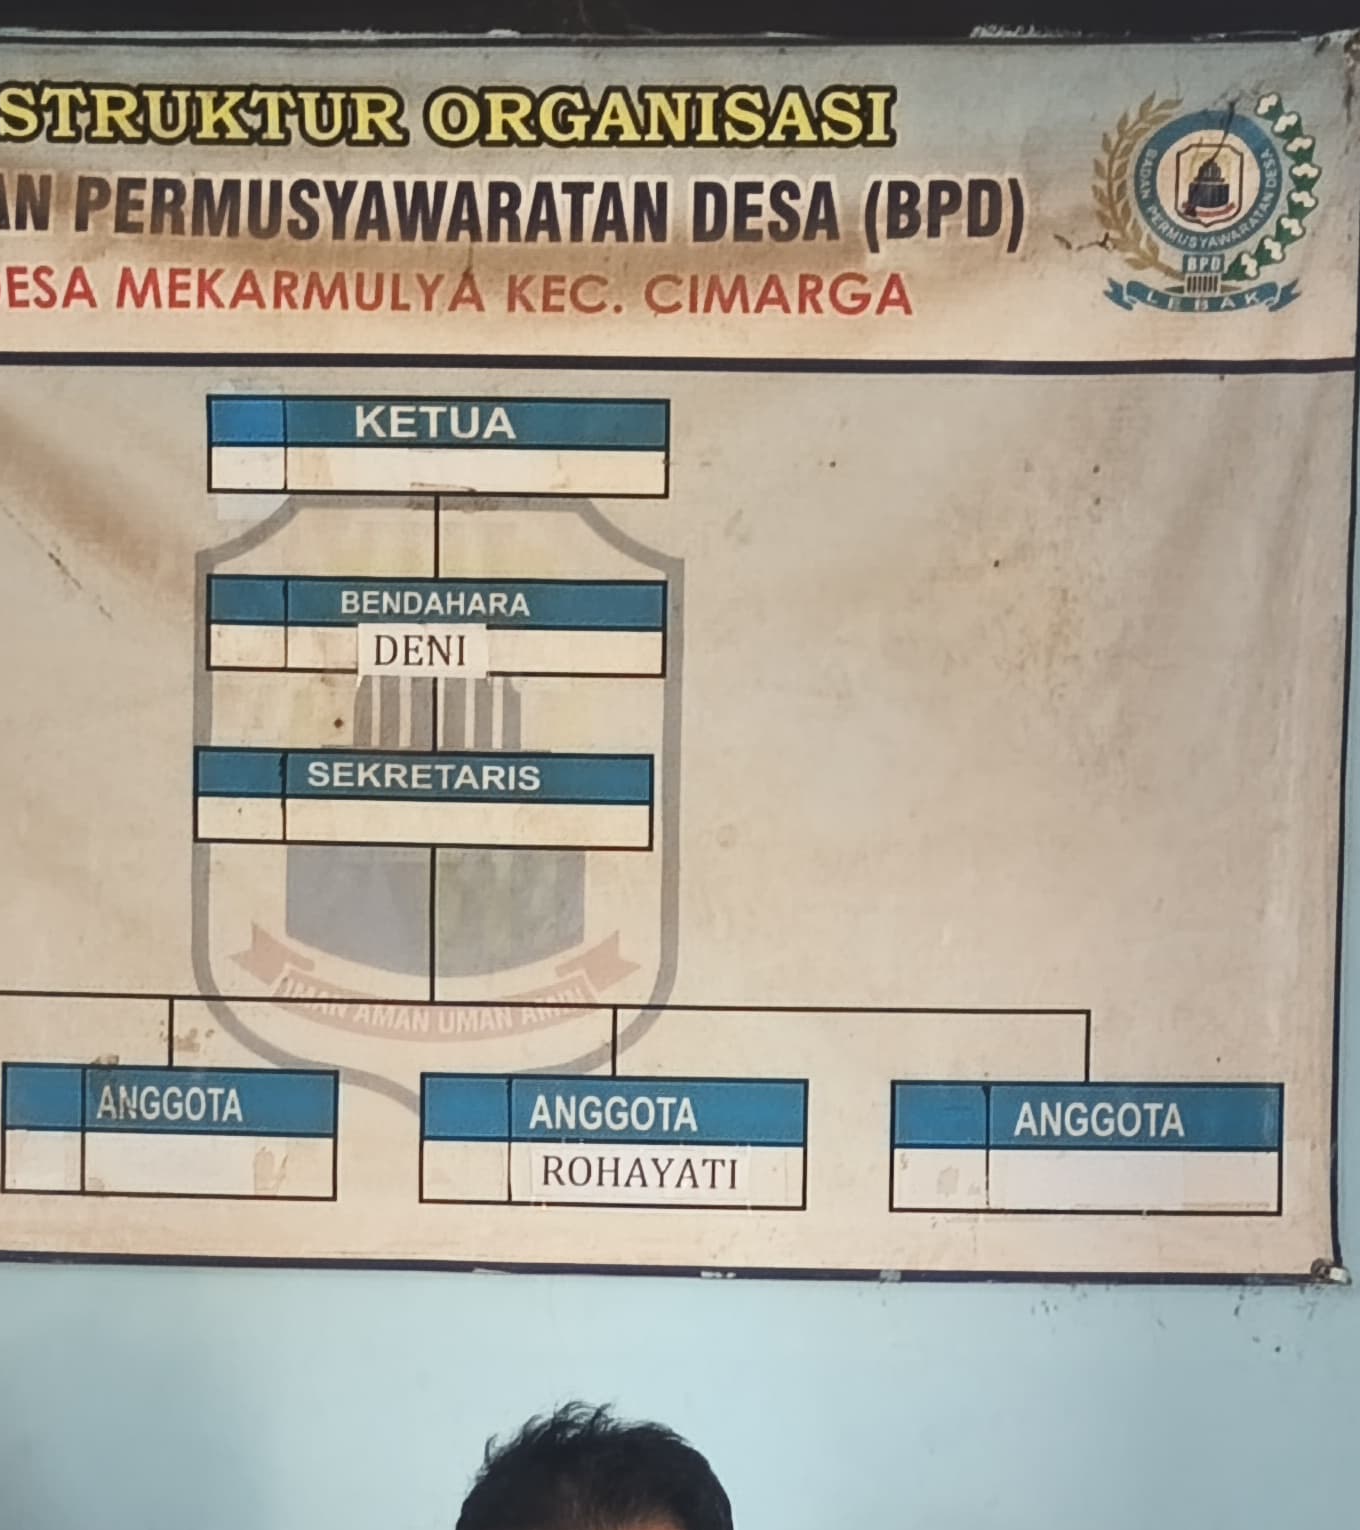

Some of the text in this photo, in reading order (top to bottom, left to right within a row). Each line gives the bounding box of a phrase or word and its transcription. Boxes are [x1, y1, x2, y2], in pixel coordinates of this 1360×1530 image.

[424, 84, 897, 147] ORGANISASI
[73, 172, 670, 245] PERMUSYAWARATAN
[694, 180, 841, 245] DESA
[863, 178, 1026, 253] (BPD)
[1186, 257, 1221, 272] BPD
[117, 267, 482, 313] MEKARMULYA
[507, 274, 625, 315] KEC.
[644, 273, 915, 317] CIMARGA
[1145, 290, 1262, 312] LEBAK
[354, 404, 517, 439] KETUA
[341, 589, 531, 617] BENDAHARA
[374, 634, 468, 667] DENI
[307, 760, 542, 792] SEKRETARIS
[354, 1005, 430, 1034] AMAN
[438, 1006, 513, 1035] UMAN
[96, 1085, 244, 1123] ANGGOTA
[528, 1095, 699, 1134] ANGGOTA
[1015, 1101, 1186, 1139] ANGGOTA
[541, 1153, 740, 1191] ROHAYATI
